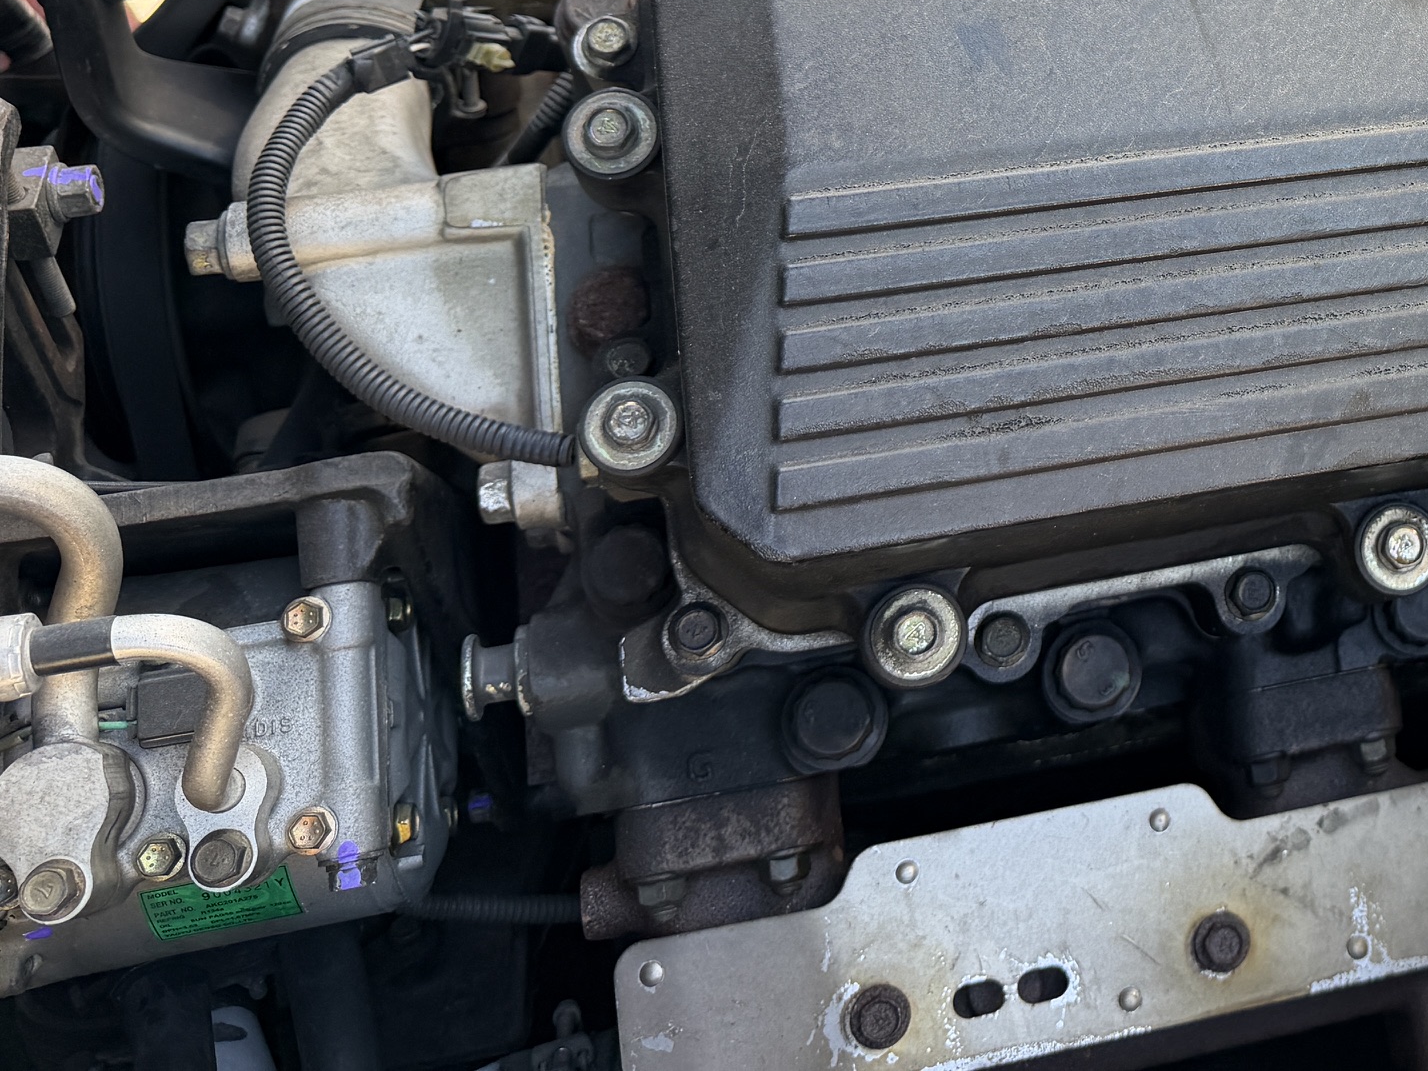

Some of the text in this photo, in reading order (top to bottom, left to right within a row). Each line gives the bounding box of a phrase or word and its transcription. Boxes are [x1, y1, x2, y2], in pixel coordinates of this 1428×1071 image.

[147, 890, 178, 900] MODEL
[150, 900, 168, 909] SER
[170, 897, 186, 905] NO.
[154, 909, 177, 918] PART
[181, 906, 197, 914] NO.
